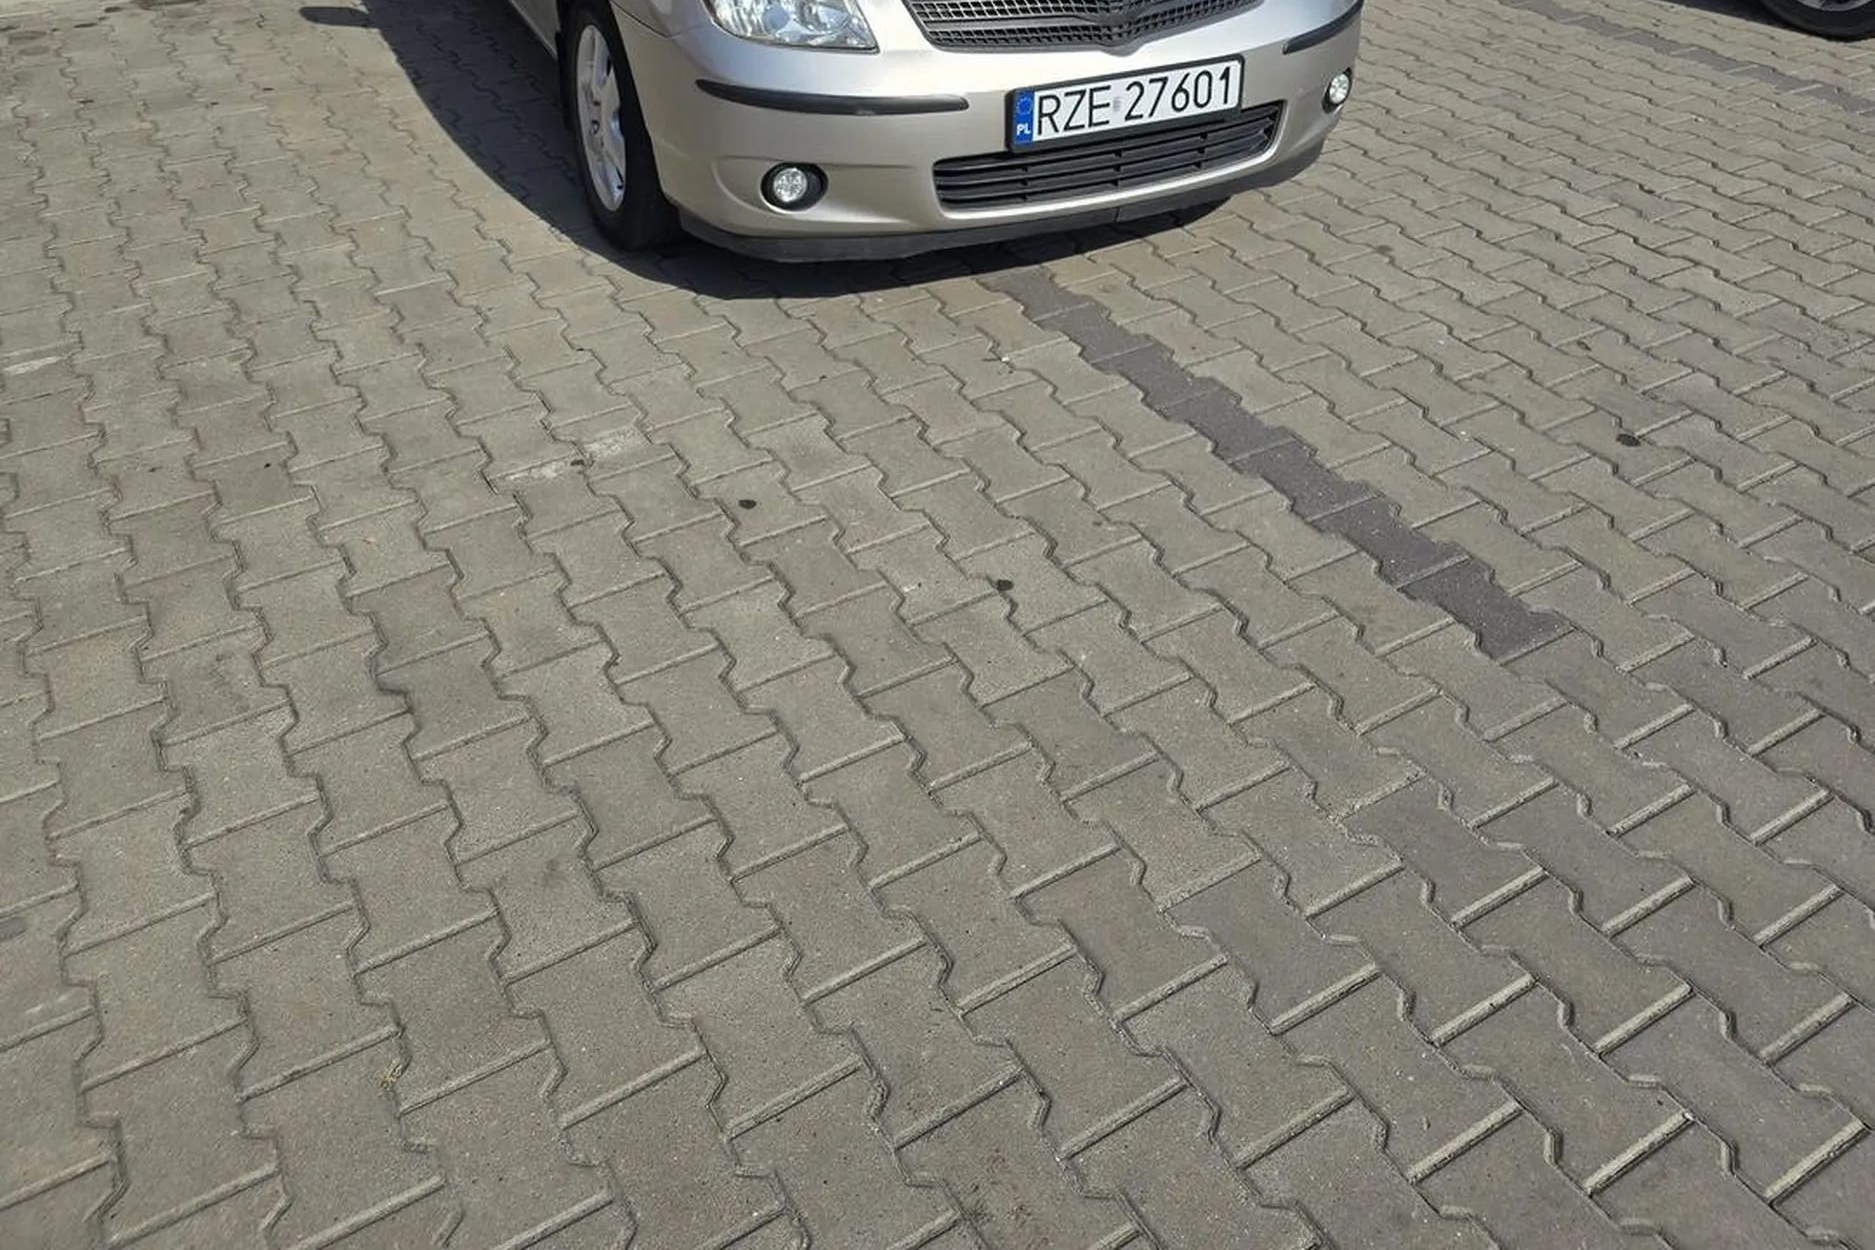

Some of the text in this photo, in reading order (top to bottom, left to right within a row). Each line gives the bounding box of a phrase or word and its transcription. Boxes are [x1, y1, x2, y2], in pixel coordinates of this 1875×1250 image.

[1037, 66, 1231, 135] RZE 27601
[1016, 124, 1031, 136] PL
